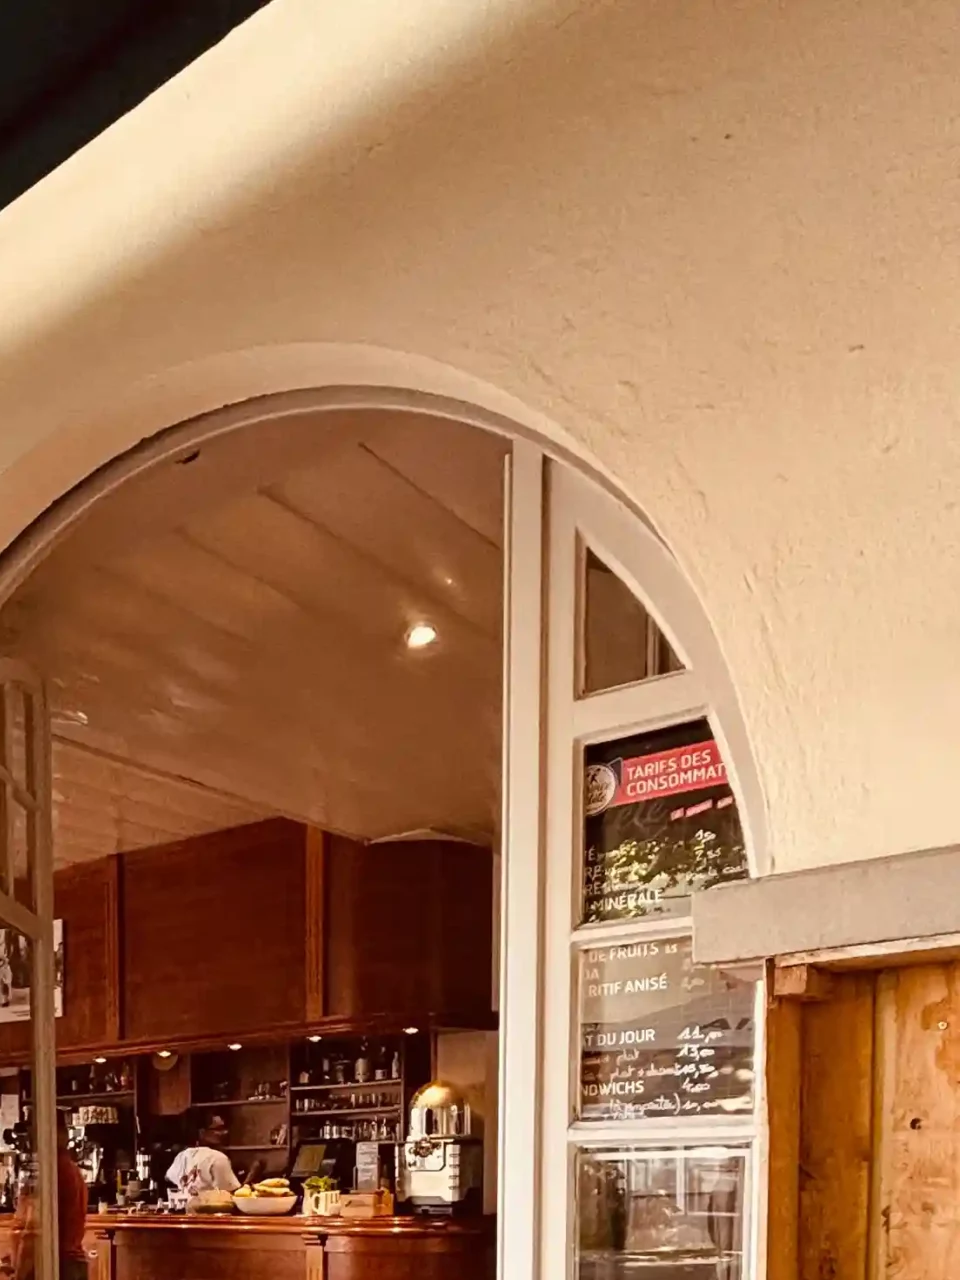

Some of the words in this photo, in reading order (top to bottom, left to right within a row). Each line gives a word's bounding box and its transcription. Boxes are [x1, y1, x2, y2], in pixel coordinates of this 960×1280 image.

[627, 758, 678, 780] TARIFS
[681, 749, 711, 769] DES
[626, 762, 728, 796] CONSOMMAT
[609, 942, 659, 960] FRUITS
[589, 982, 622, 998] RITIF
[624, 972, 668, 993] ANISÉ
[597, 1034, 617, 1046] DU
[619, 1028, 656, 1045] JOUR
